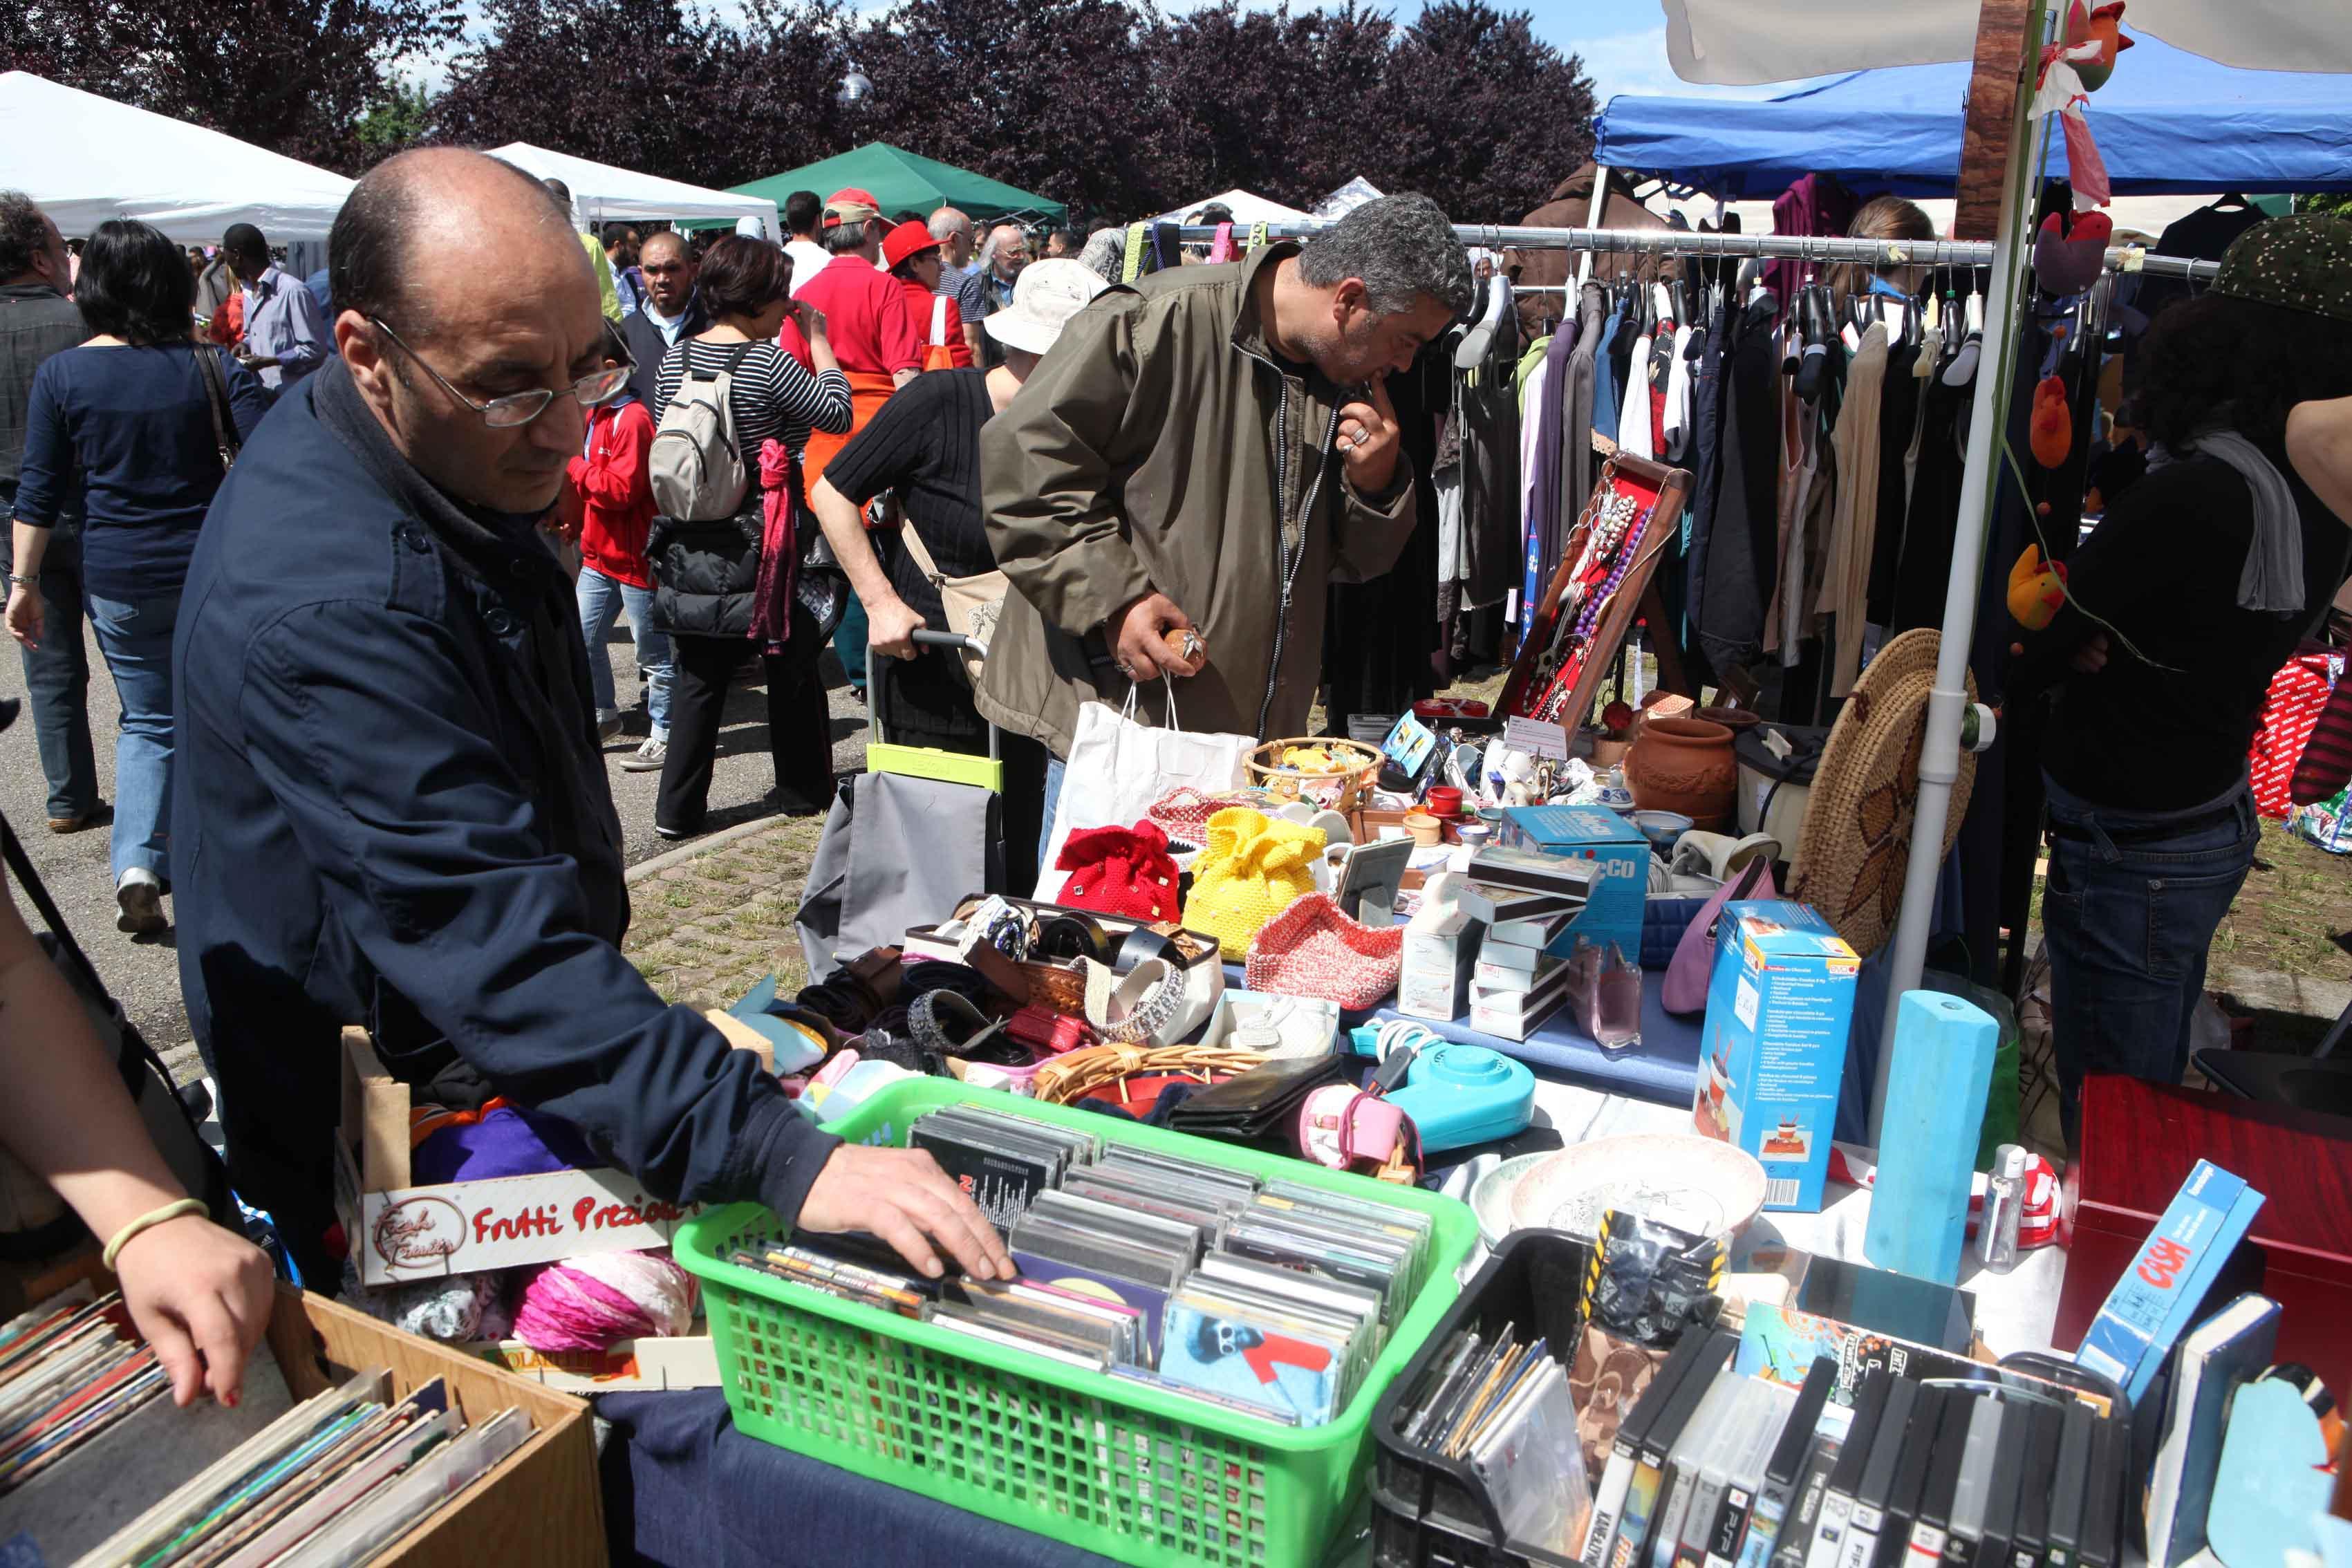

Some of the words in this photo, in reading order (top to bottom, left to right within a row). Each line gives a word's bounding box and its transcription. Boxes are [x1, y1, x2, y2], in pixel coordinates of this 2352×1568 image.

[2277, 678, 2296, 687] PARIS
[2297, 680, 2317, 690] PARIS
[2291, 692, 2311, 701] PARIS
[2286, 703, 2304, 713] PARIS
[2271, 761, 2290, 772] PARIS
[2268, 774, 2286, 784] PARIS
[2264, 785, 2282, 796] PARIS
[473, 1204, 564, 1244] Frutti
[2137, 1236, 2192, 1290] CASH
[1719, 1511, 1739, 1553] PSP
